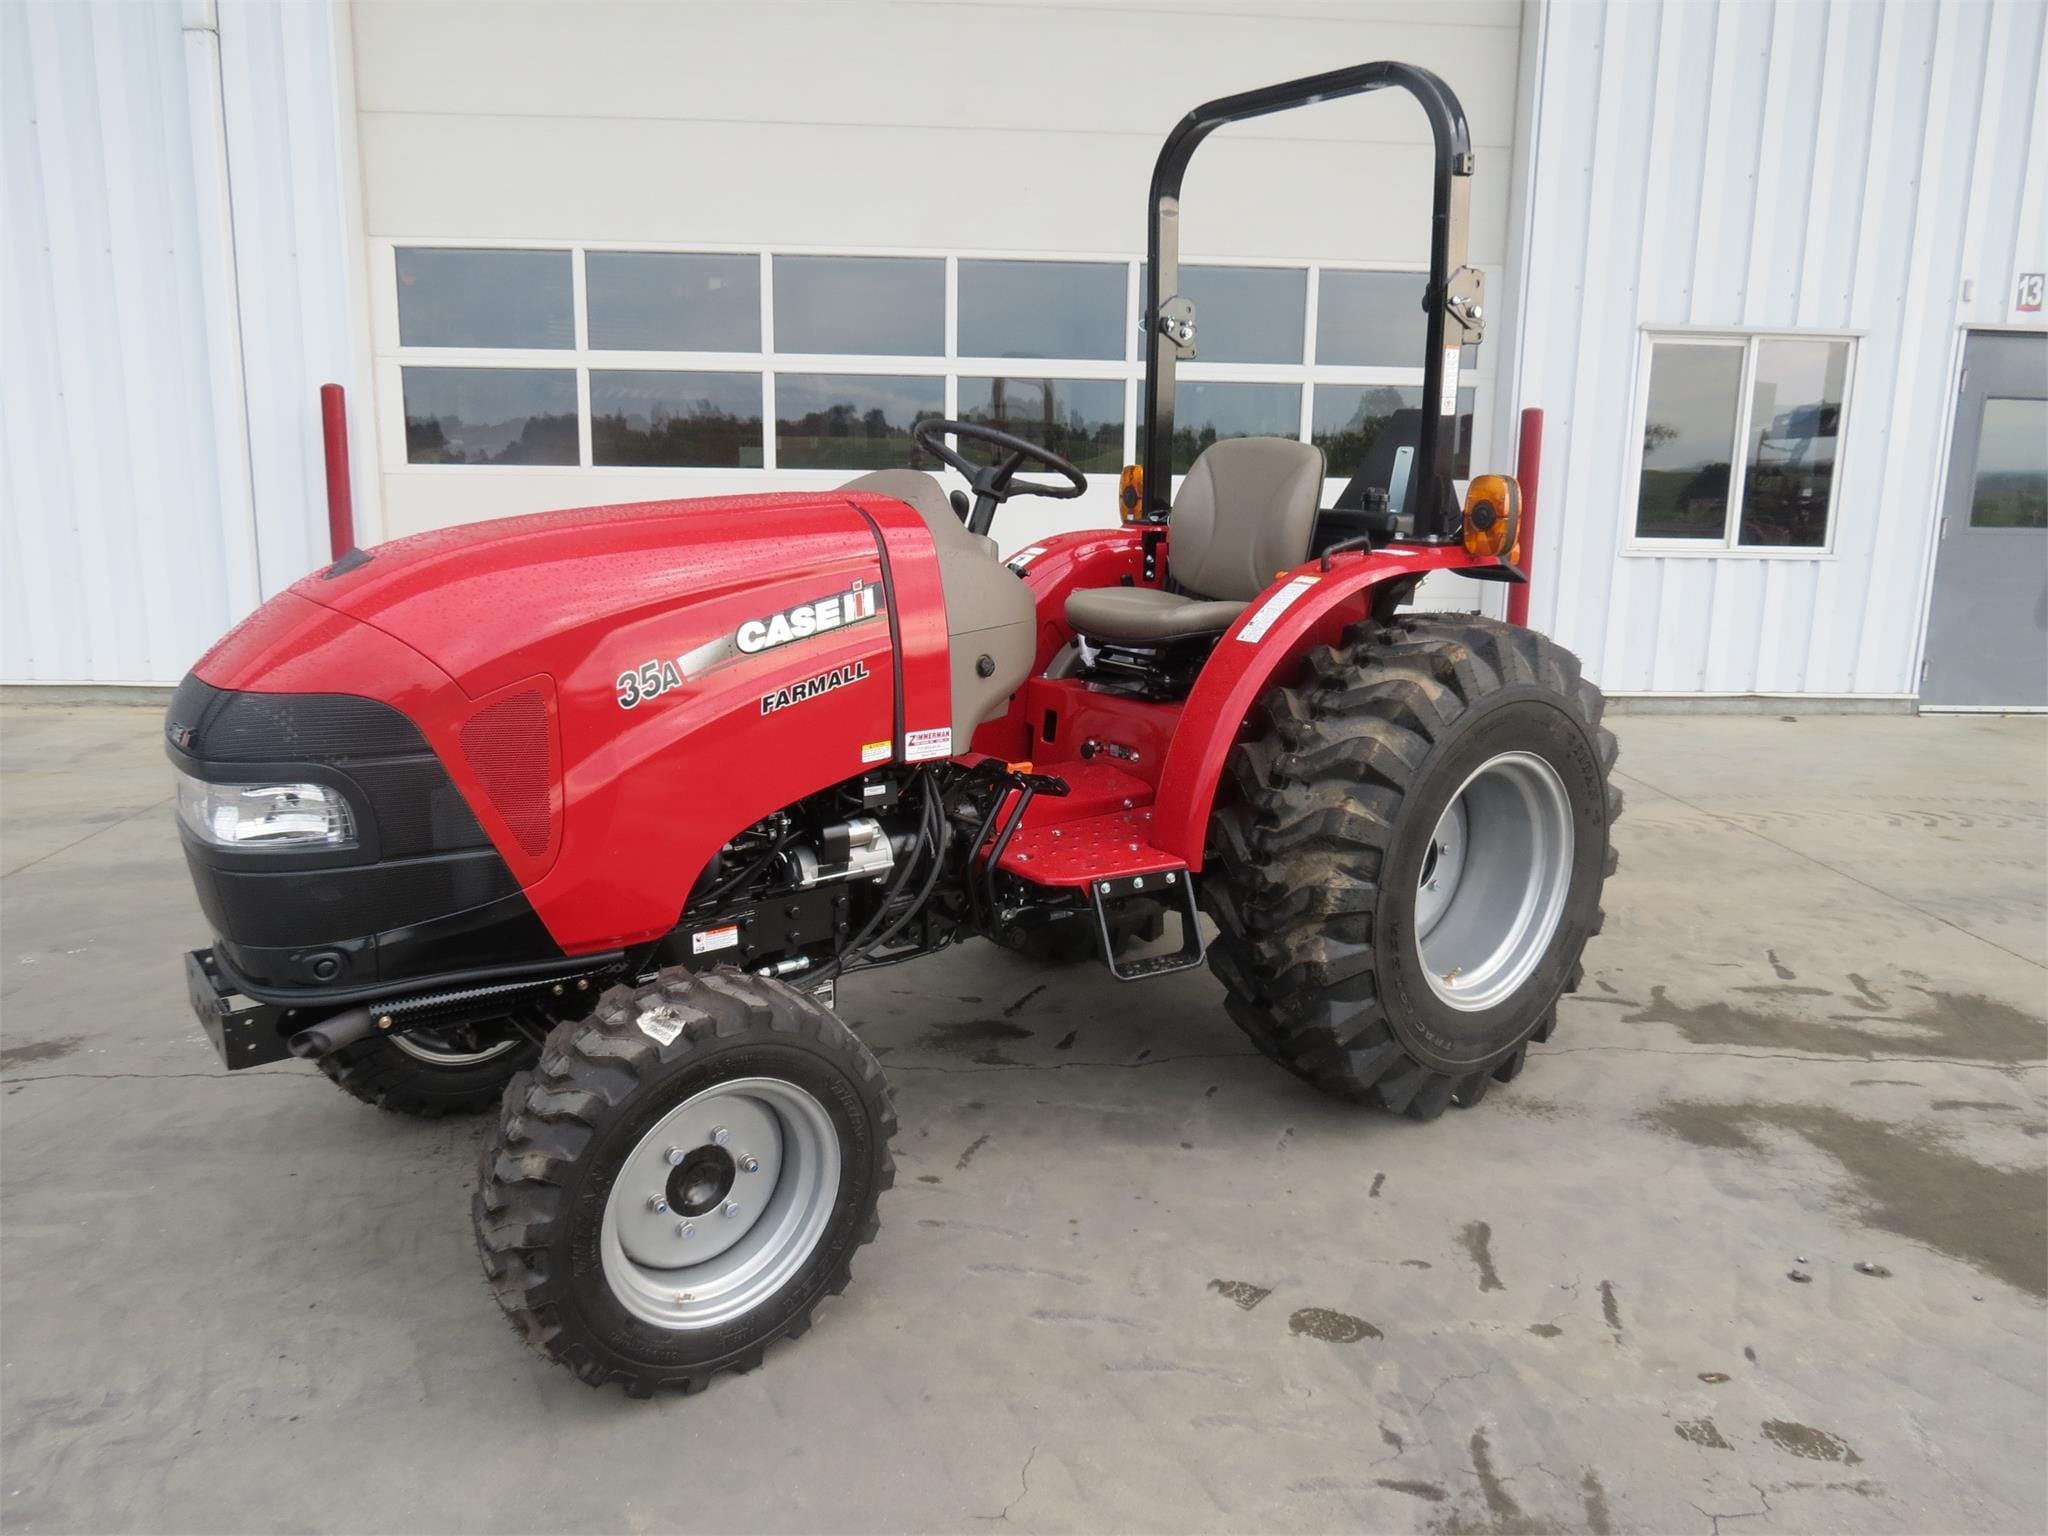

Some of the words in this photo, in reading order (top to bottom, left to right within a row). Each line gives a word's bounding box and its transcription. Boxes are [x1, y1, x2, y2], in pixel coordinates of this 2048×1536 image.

[2018, 275, 2043, 306] 13
[736, 598, 841, 653] CASE
[617, 659, 682, 709] 35A
[761, 661, 870, 716] FARMALL
[908, 730, 950, 747] ZIMMERMAN
